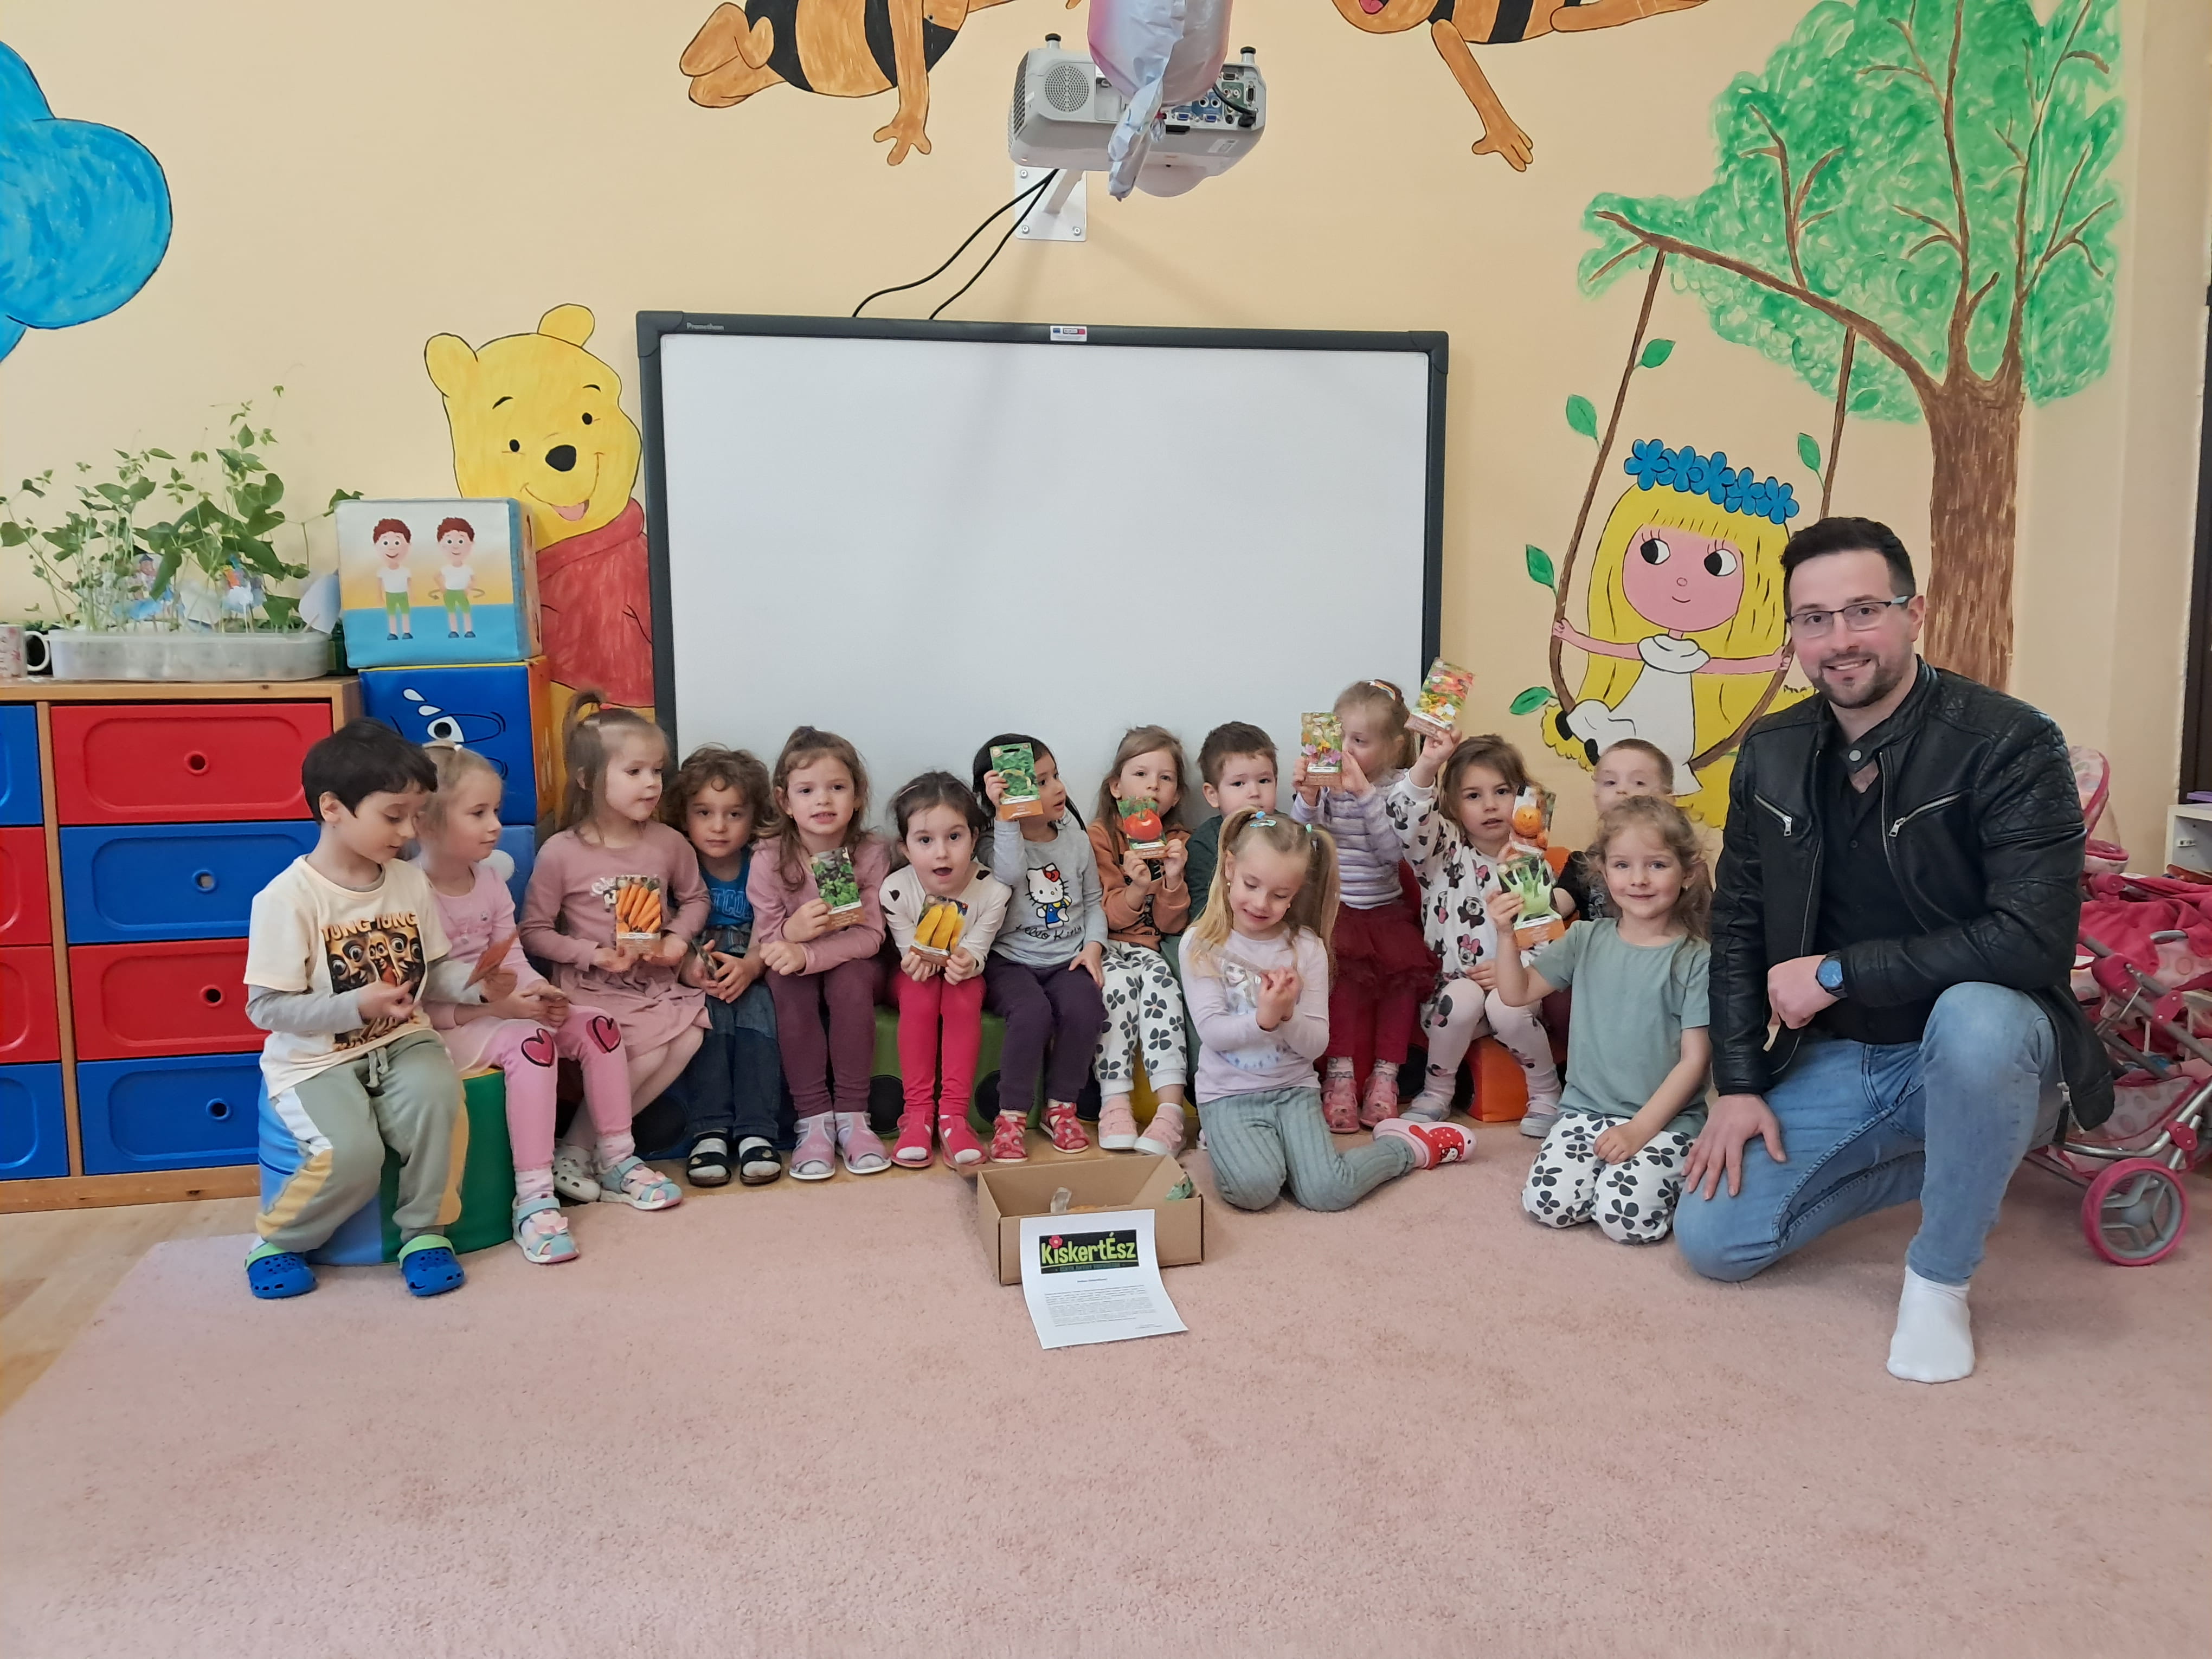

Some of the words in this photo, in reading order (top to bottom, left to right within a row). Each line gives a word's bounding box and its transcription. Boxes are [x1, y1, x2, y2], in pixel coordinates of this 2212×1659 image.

[686, 321, 724, 330] Promethean
[321, 918, 371, 941] TUNG
[374, 912, 419, 930] TUNG
[1040, 1231, 1136, 1264] KiskertÉsz
